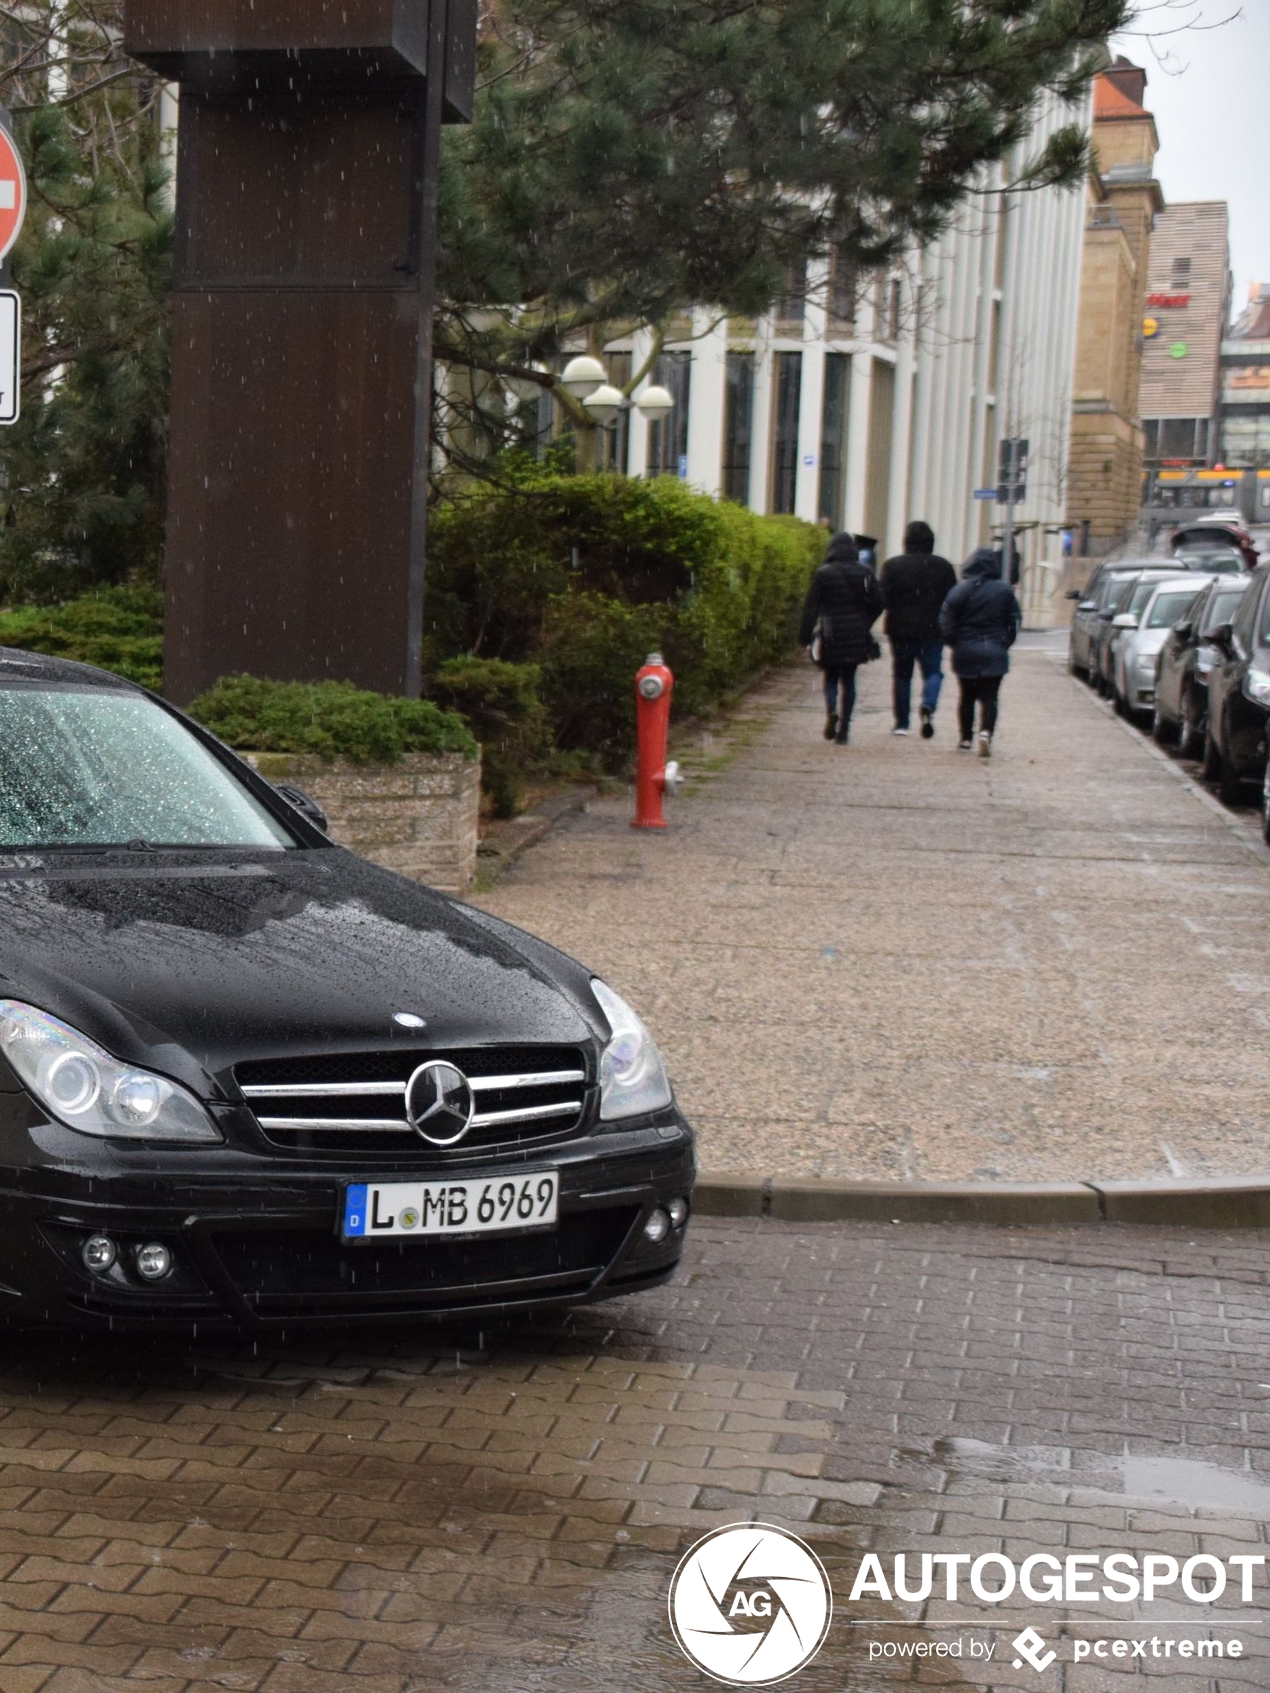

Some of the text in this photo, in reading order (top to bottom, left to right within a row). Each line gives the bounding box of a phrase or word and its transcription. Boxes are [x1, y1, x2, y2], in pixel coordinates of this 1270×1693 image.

[371, 1190, 394, 1229] L
[477, 1177, 554, 1224] 6969
[349, 1215, 359, 1228] D
